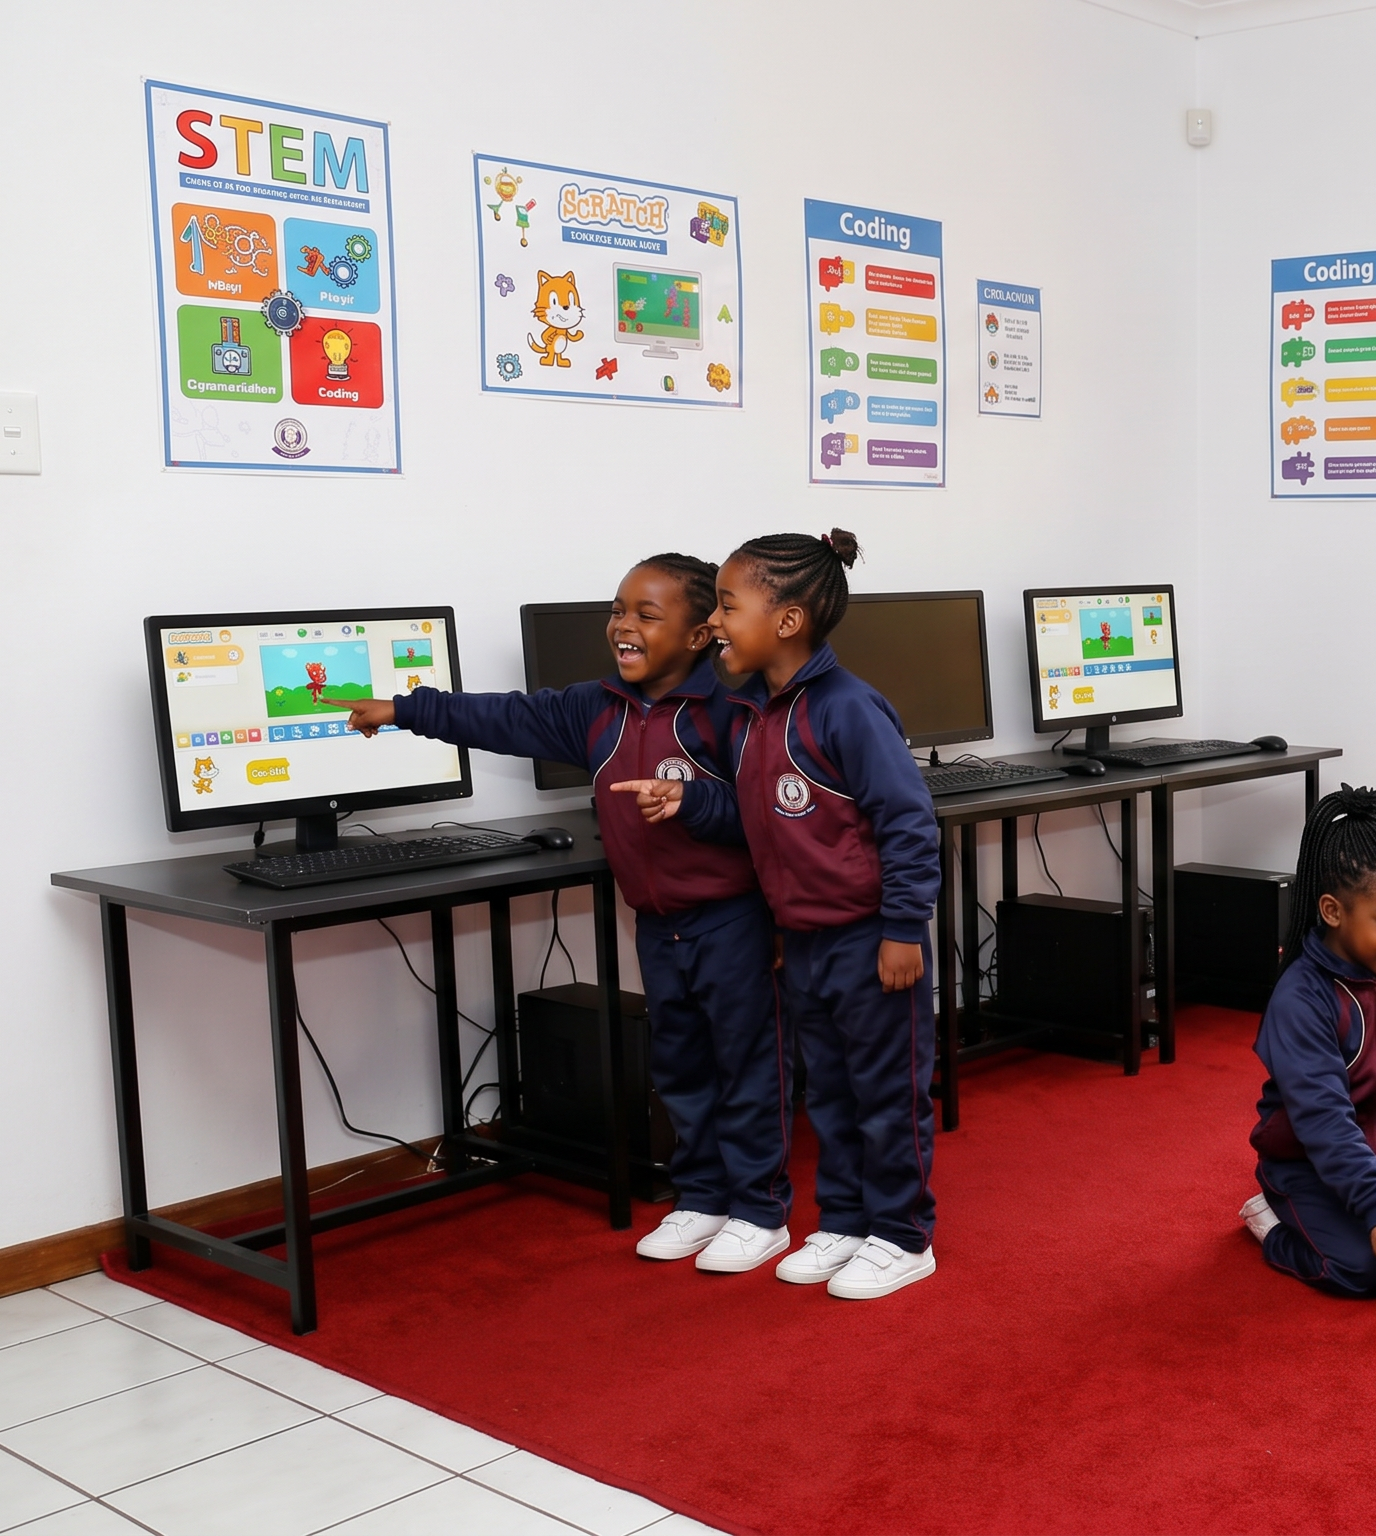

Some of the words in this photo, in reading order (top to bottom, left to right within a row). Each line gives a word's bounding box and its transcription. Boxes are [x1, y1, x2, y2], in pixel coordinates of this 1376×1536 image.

[176, 109, 369, 194] STEM
[562, 188, 665, 230] SCRATCH
[839, 211, 911, 250] Coding
[1303, 258, 1374, 284] Coding
